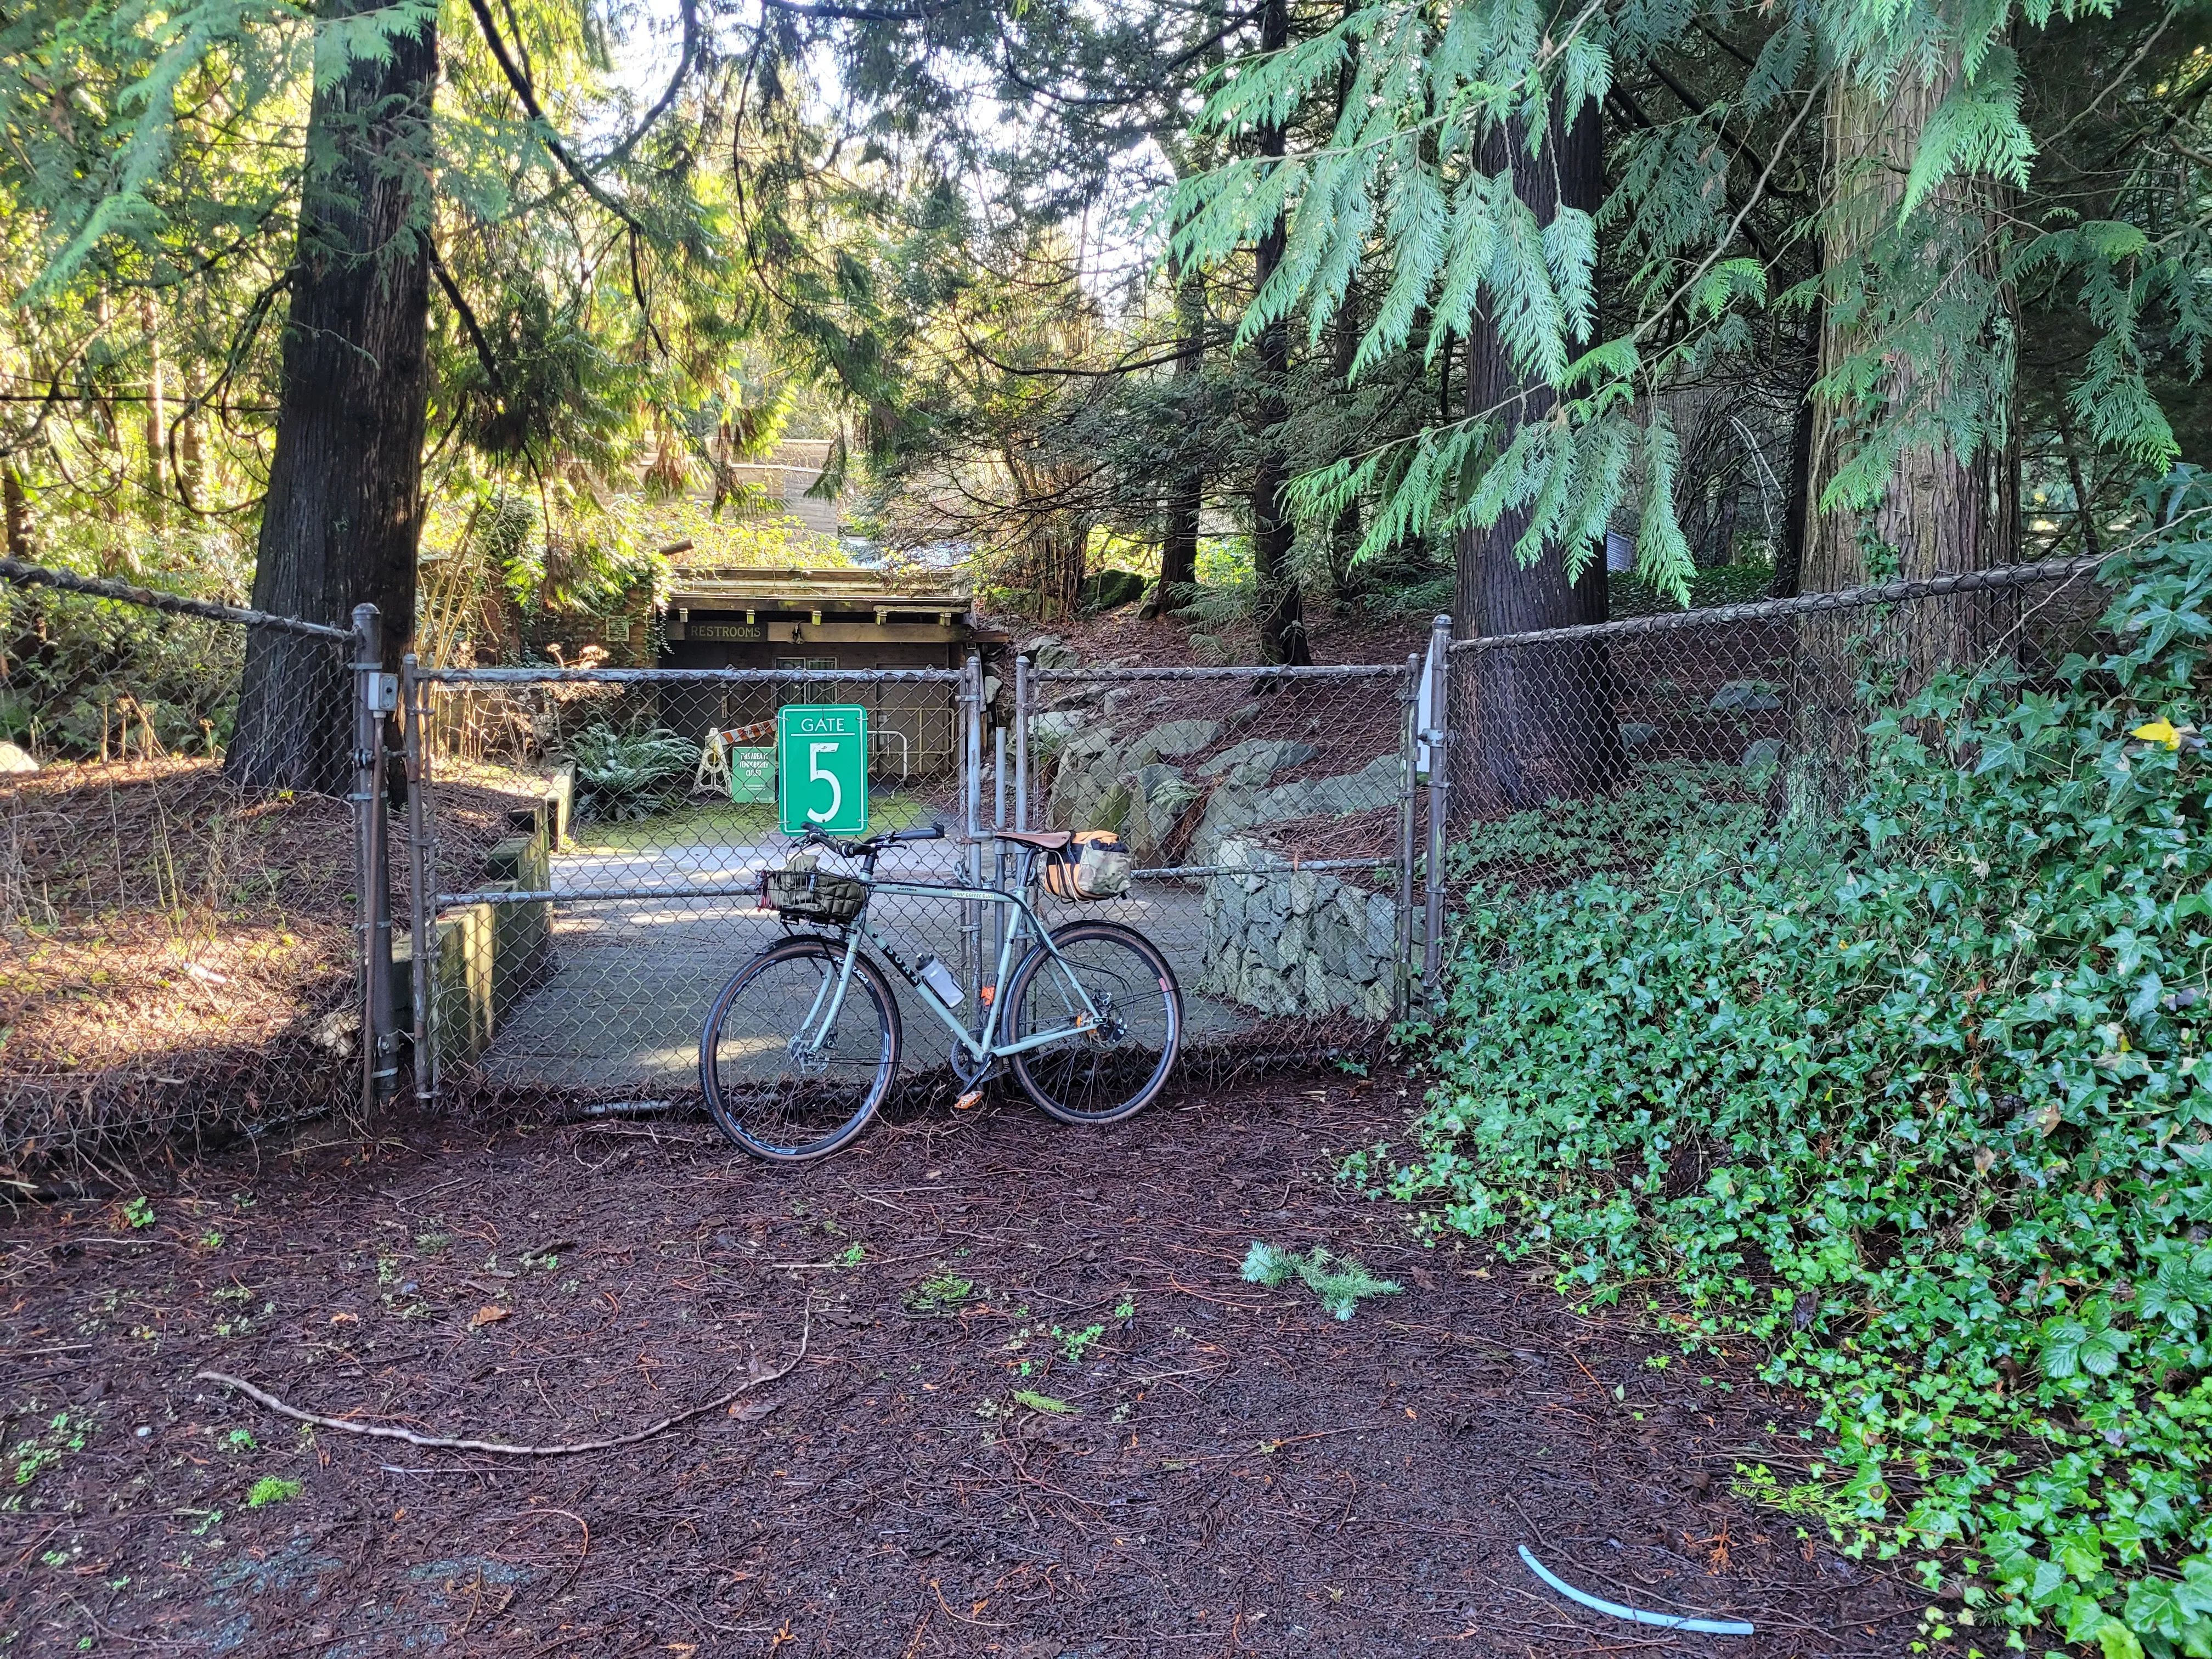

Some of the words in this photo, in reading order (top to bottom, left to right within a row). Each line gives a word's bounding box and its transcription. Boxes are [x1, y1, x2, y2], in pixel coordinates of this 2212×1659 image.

[691, 626, 761, 637] RESTROOMS
[801, 718, 845, 732] GATE
[806, 742, 841, 823] 5
[837, 957, 869, 984] KUGA
[887, 947, 918, 984] SOMA
[726, 1111, 798, 1155] BOYD
